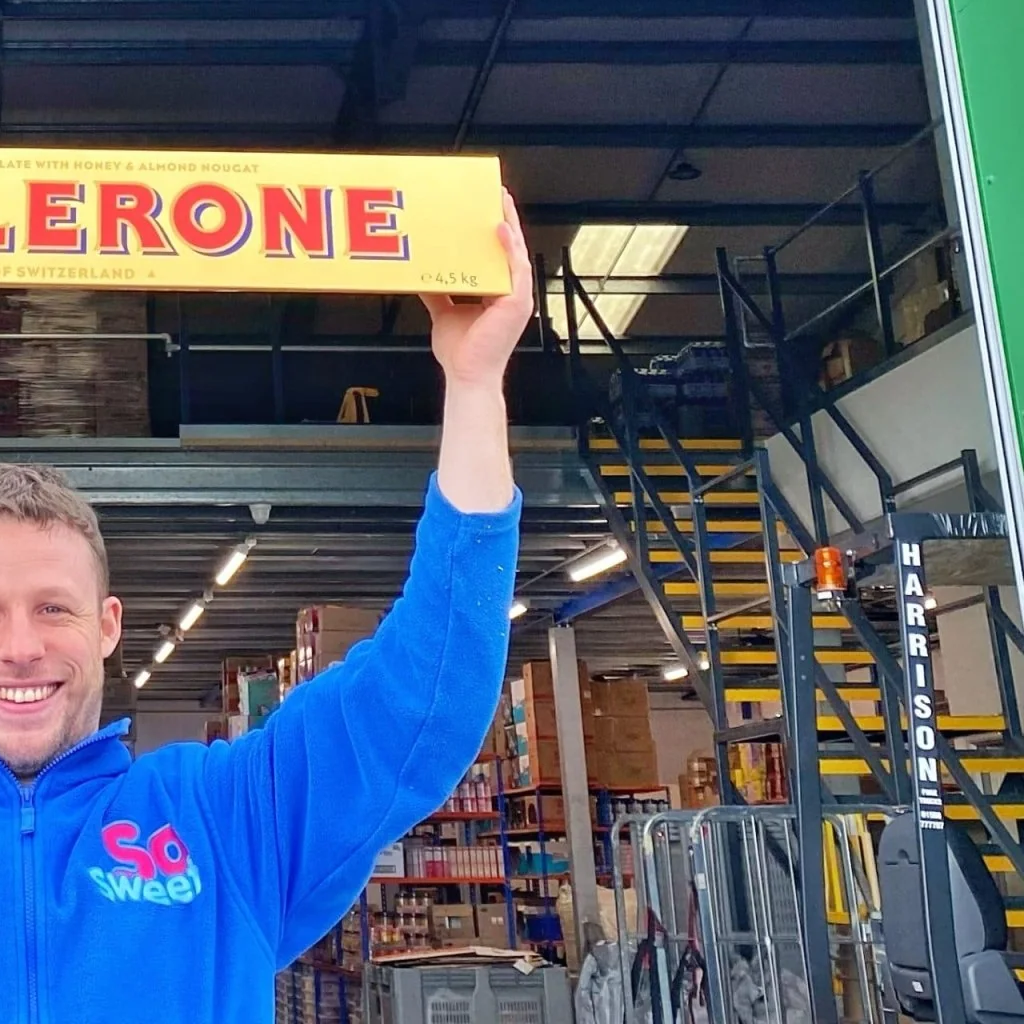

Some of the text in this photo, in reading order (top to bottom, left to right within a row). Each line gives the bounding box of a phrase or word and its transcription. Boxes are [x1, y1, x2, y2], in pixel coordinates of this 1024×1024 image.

[35, 159, 69, 170] WITH
[73, 160, 123, 171] HONEY
[125, 162, 135, 171] &
[138, 161, 198, 172] ALMOND
[201, 162, 261, 173] NOUGAT
[16, 266, 136, 280] SWITZERLAND
[435, 272, 458, 285] 4,5
[461, 271, 479, 287] kg
[901, 542, 939, 782] HARRISON
